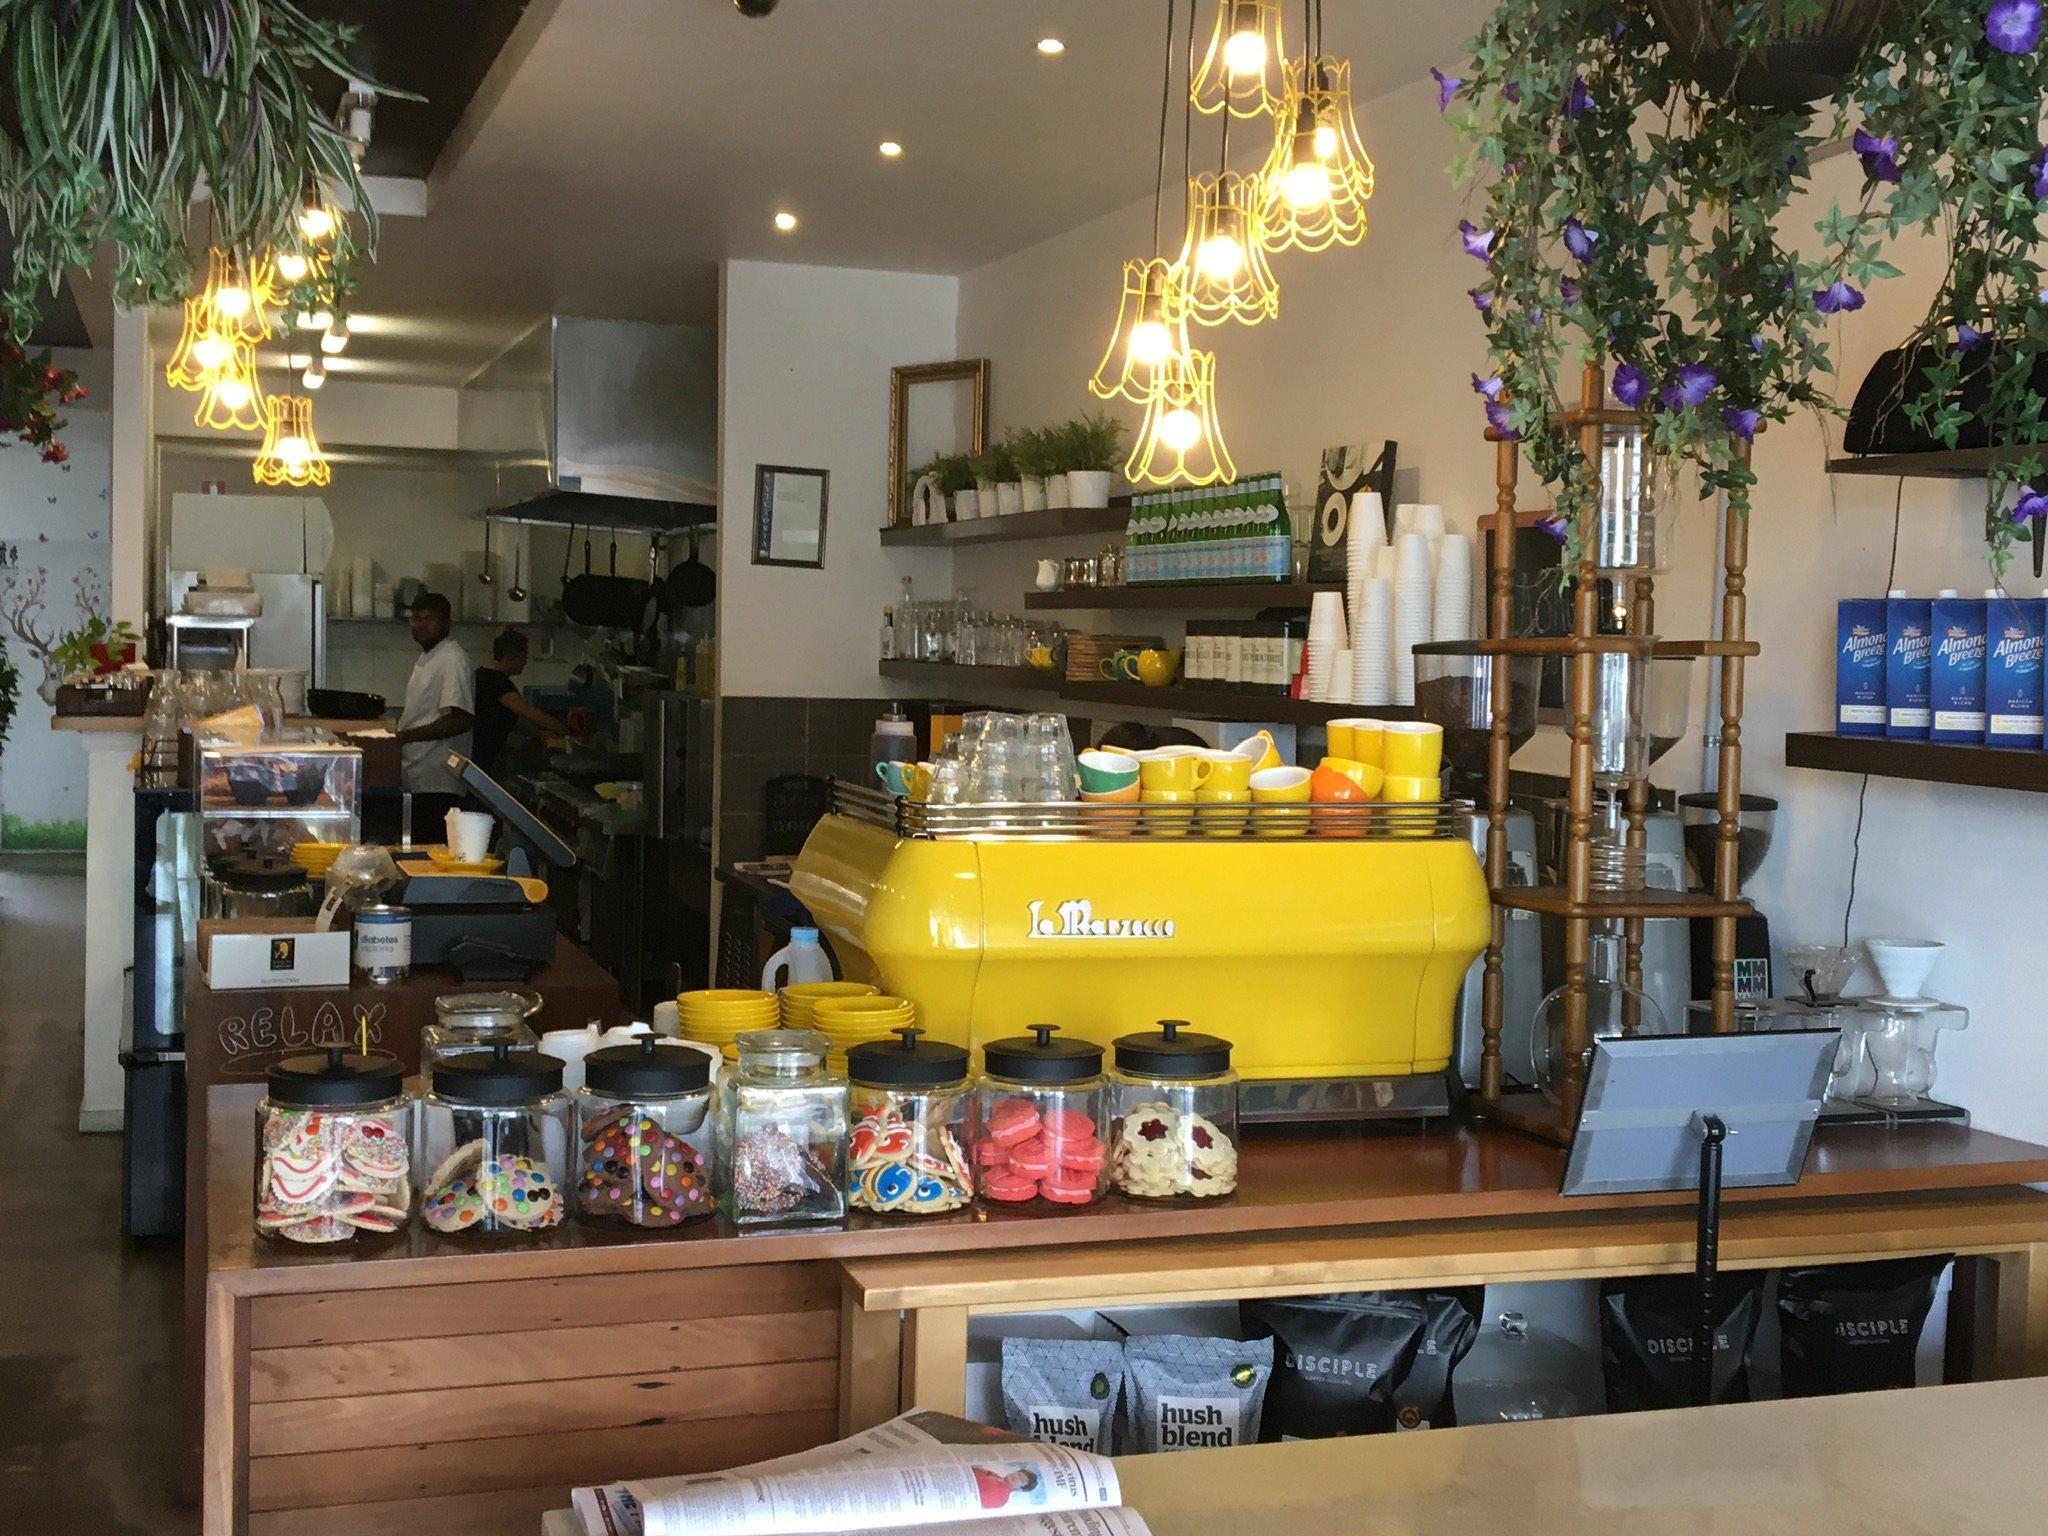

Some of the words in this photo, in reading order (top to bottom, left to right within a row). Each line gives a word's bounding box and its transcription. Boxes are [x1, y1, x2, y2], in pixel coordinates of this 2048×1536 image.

[360, 934, 399, 944] diabetes
[218, 1002, 386, 1055] RELAX
[1033, 1412, 1088, 1437] hush
[1161, 1403, 1223, 1426] hush
[1161, 1425, 1233, 1448] blend
